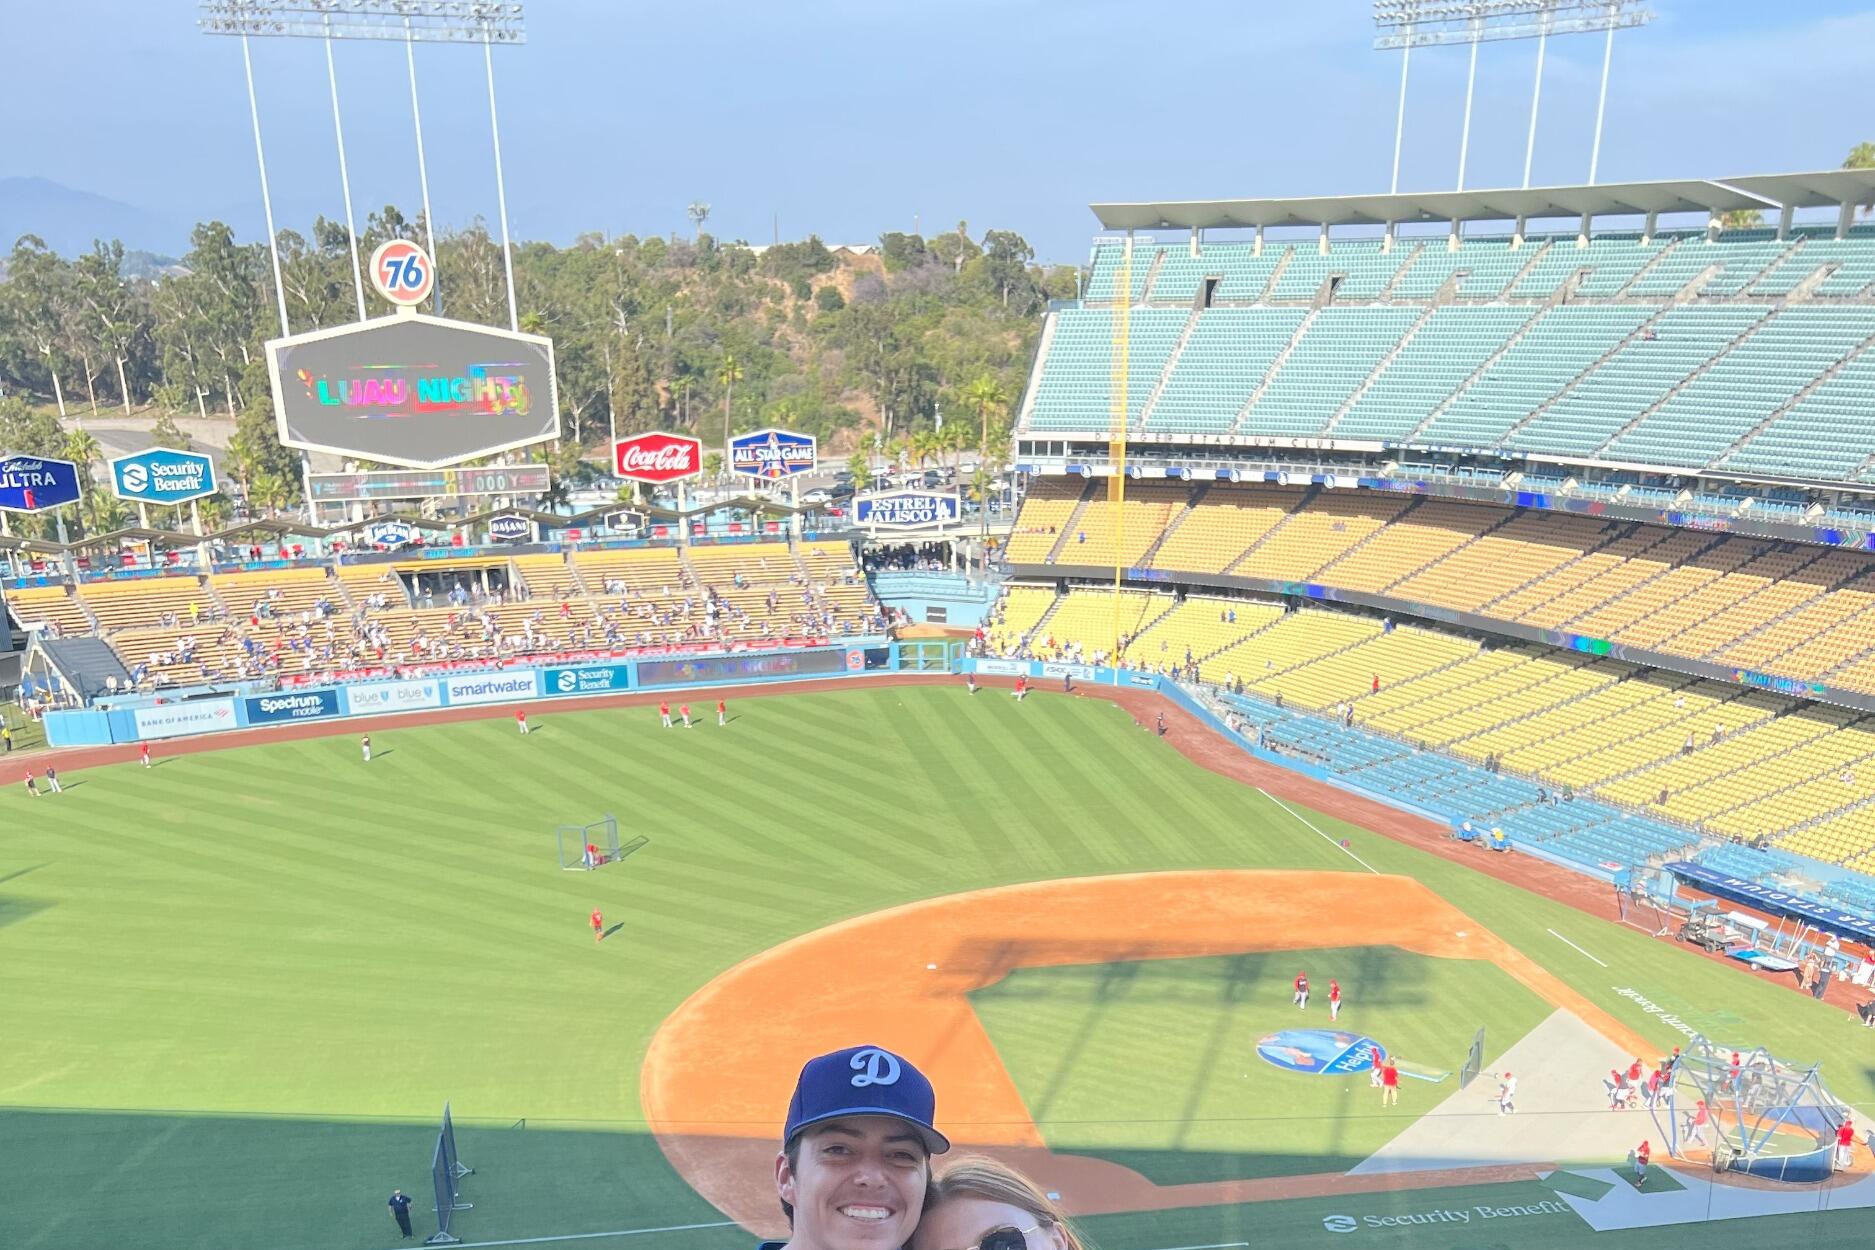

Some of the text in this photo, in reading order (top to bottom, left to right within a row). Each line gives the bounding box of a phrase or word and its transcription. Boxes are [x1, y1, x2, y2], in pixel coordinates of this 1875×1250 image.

[385, 254, 424, 290] 76
[316, 377, 408, 406] LUAU
[1190, 433, 1275, 446] STADIUM
[1291, 438, 1335, 450] CLUB
[735, 447, 813, 461] ALL STAR GAME
[151, 461, 204, 478] Security
[154, 477, 202, 492] Benefit
[864, 509, 933, 523] JALISCO
[578, 668, 615, 682] Security
[397, 687, 422, 699] blue
[452, 678, 533, 697] smartwater
[260, 695, 321, 714] Spectrum
[353, 691, 379, 703] blue
[141, 718, 164, 727] BANK
[177, 713, 213, 722] AMERICA
[849, 1048, 901, 1087] D
[1363, 1199, 1571, 1228] Security Benefit
